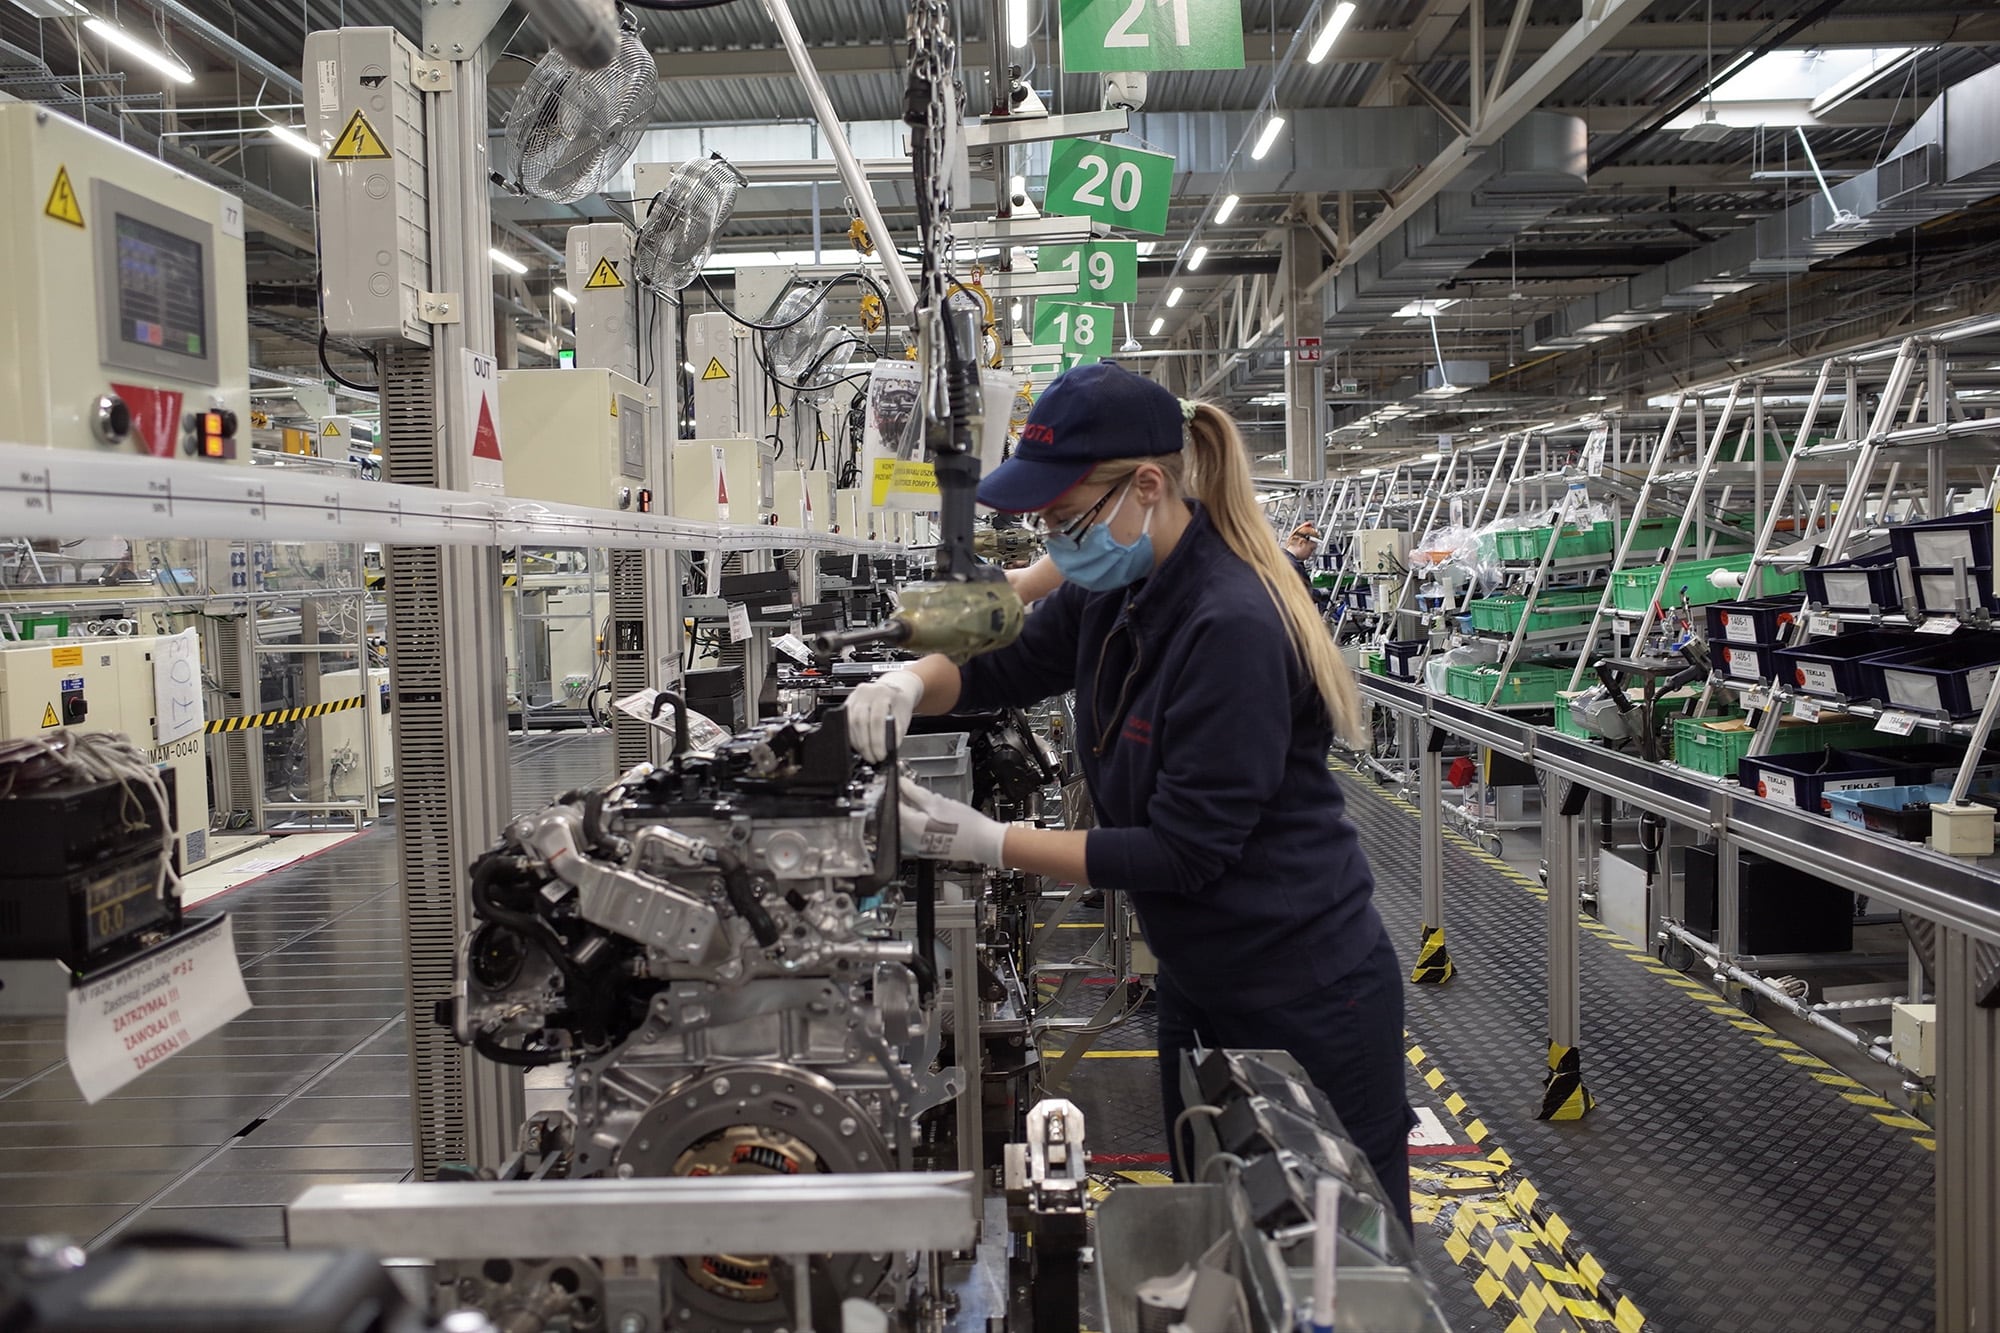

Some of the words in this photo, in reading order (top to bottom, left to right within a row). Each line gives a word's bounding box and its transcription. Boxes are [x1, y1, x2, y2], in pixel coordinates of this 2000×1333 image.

[1103, 0, 1190, 48] 21
[1073, 154, 1144, 212] 20
[226, 207, 239, 225] 77
[1062, 250, 1115, 290] 19
[1053, 311, 1095, 346] 18
[474, 357, 491, 379] OUT
[1022, 423, 1054, 445] OTA
[1805, 669, 1826, 678] TEKLAS
[1766, 775, 1787, 786] TEKLAS
[1840, 782, 1880, 791] TEKLAS
[113, 996, 168, 1032] ZATRZYMAJ
[133, 1035, 180, 1070] ZACZEKAJ
